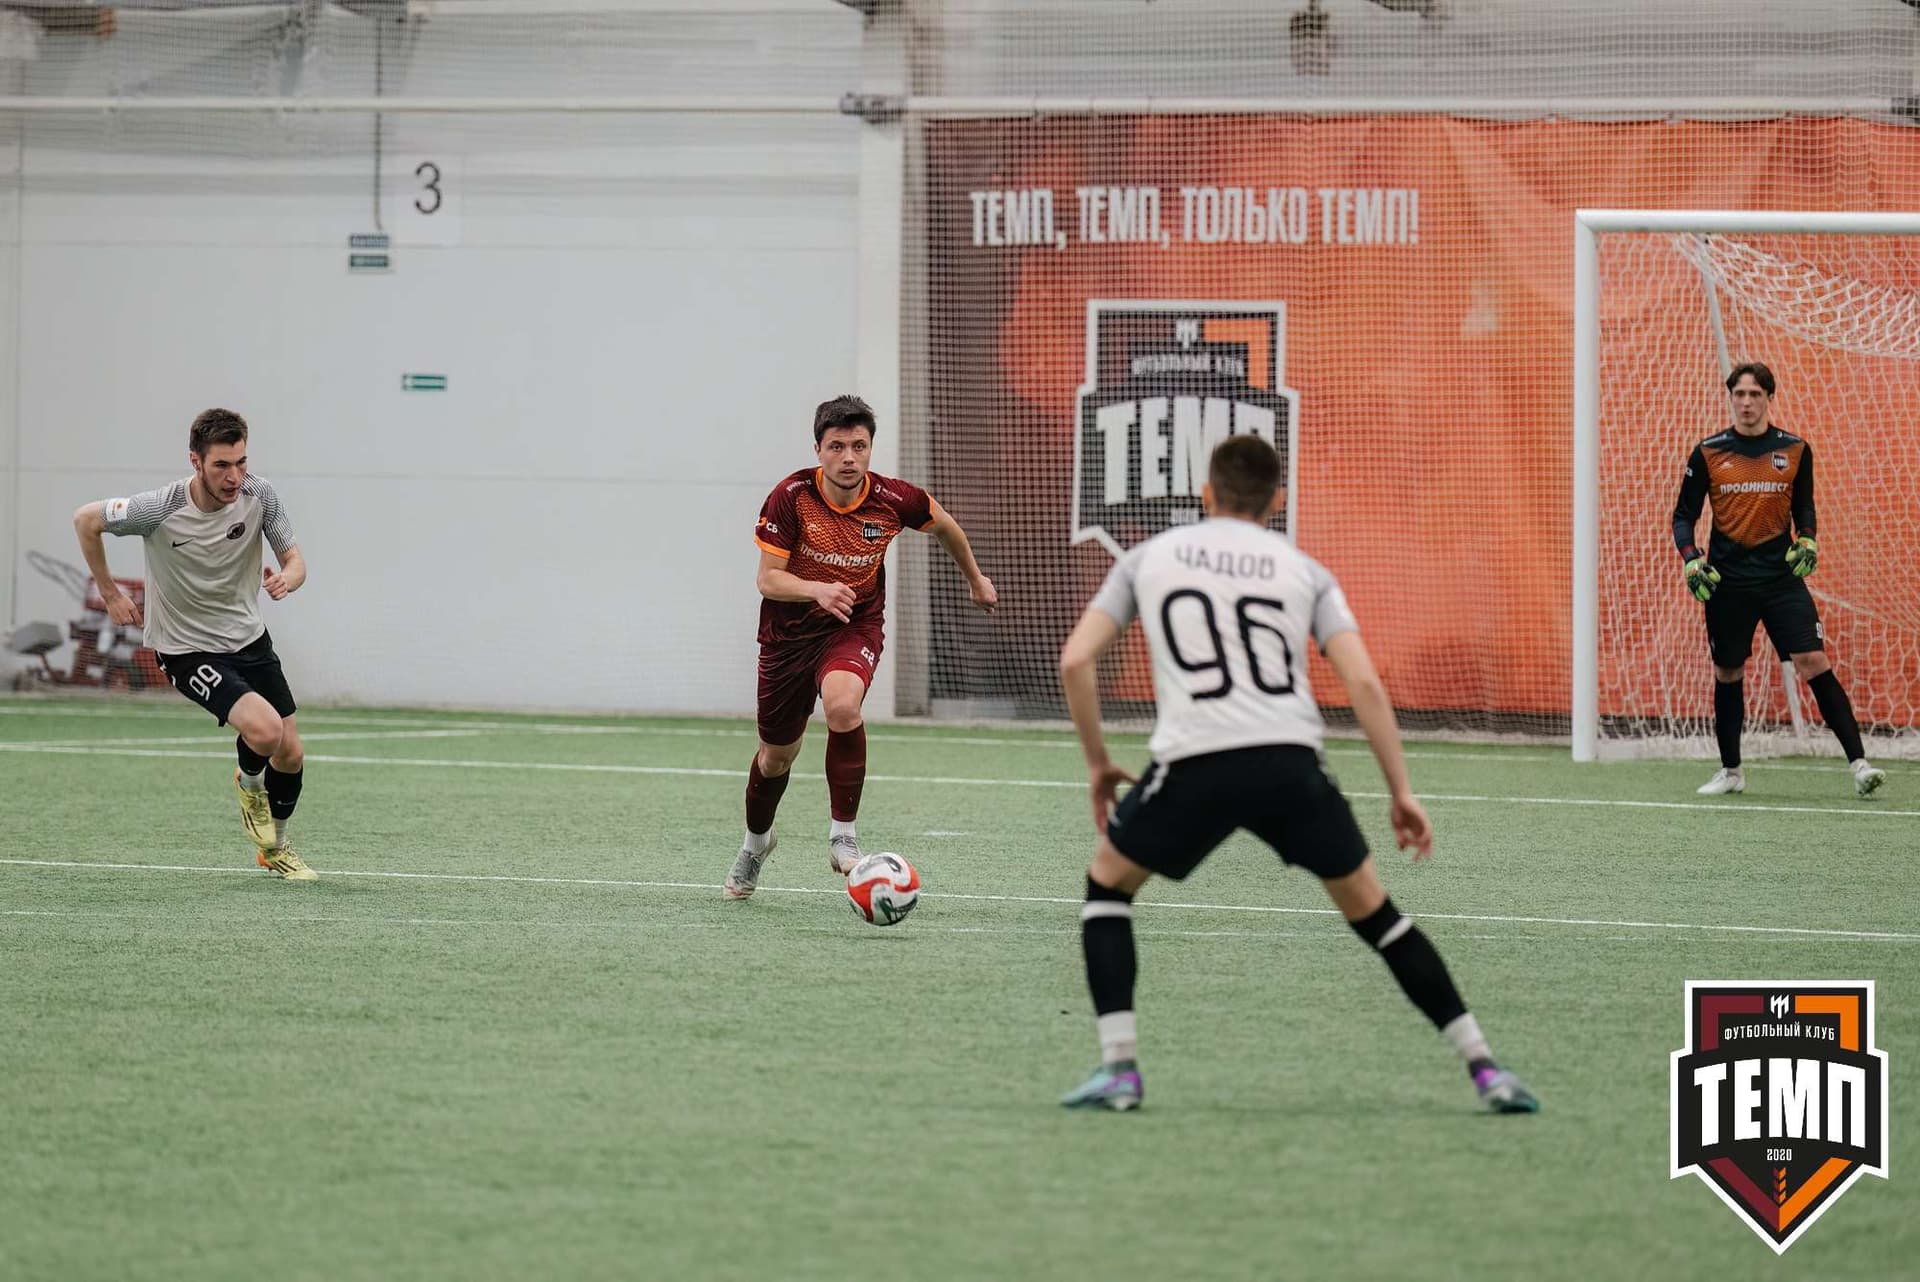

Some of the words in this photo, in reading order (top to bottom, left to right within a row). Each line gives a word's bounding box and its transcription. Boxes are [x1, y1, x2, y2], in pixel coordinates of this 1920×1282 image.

[415, 161, 441, 215] 3
[970, 191, 1067, 250] ТЕМП,
[1078, 188, 1170, 250] ТЕМП,
[1181, 187, 1306, 243] ТОЛЬКО
[1317, 188, 1418, 245] ТЕМП!
[1720, 481, 1788, 494] ПРОДИНВЕСТ
[1175, 544, 1275, 580] ЧАДОВ
[1161, 588, 1295, 701] 96
[189, 664, 222, 701] 99
